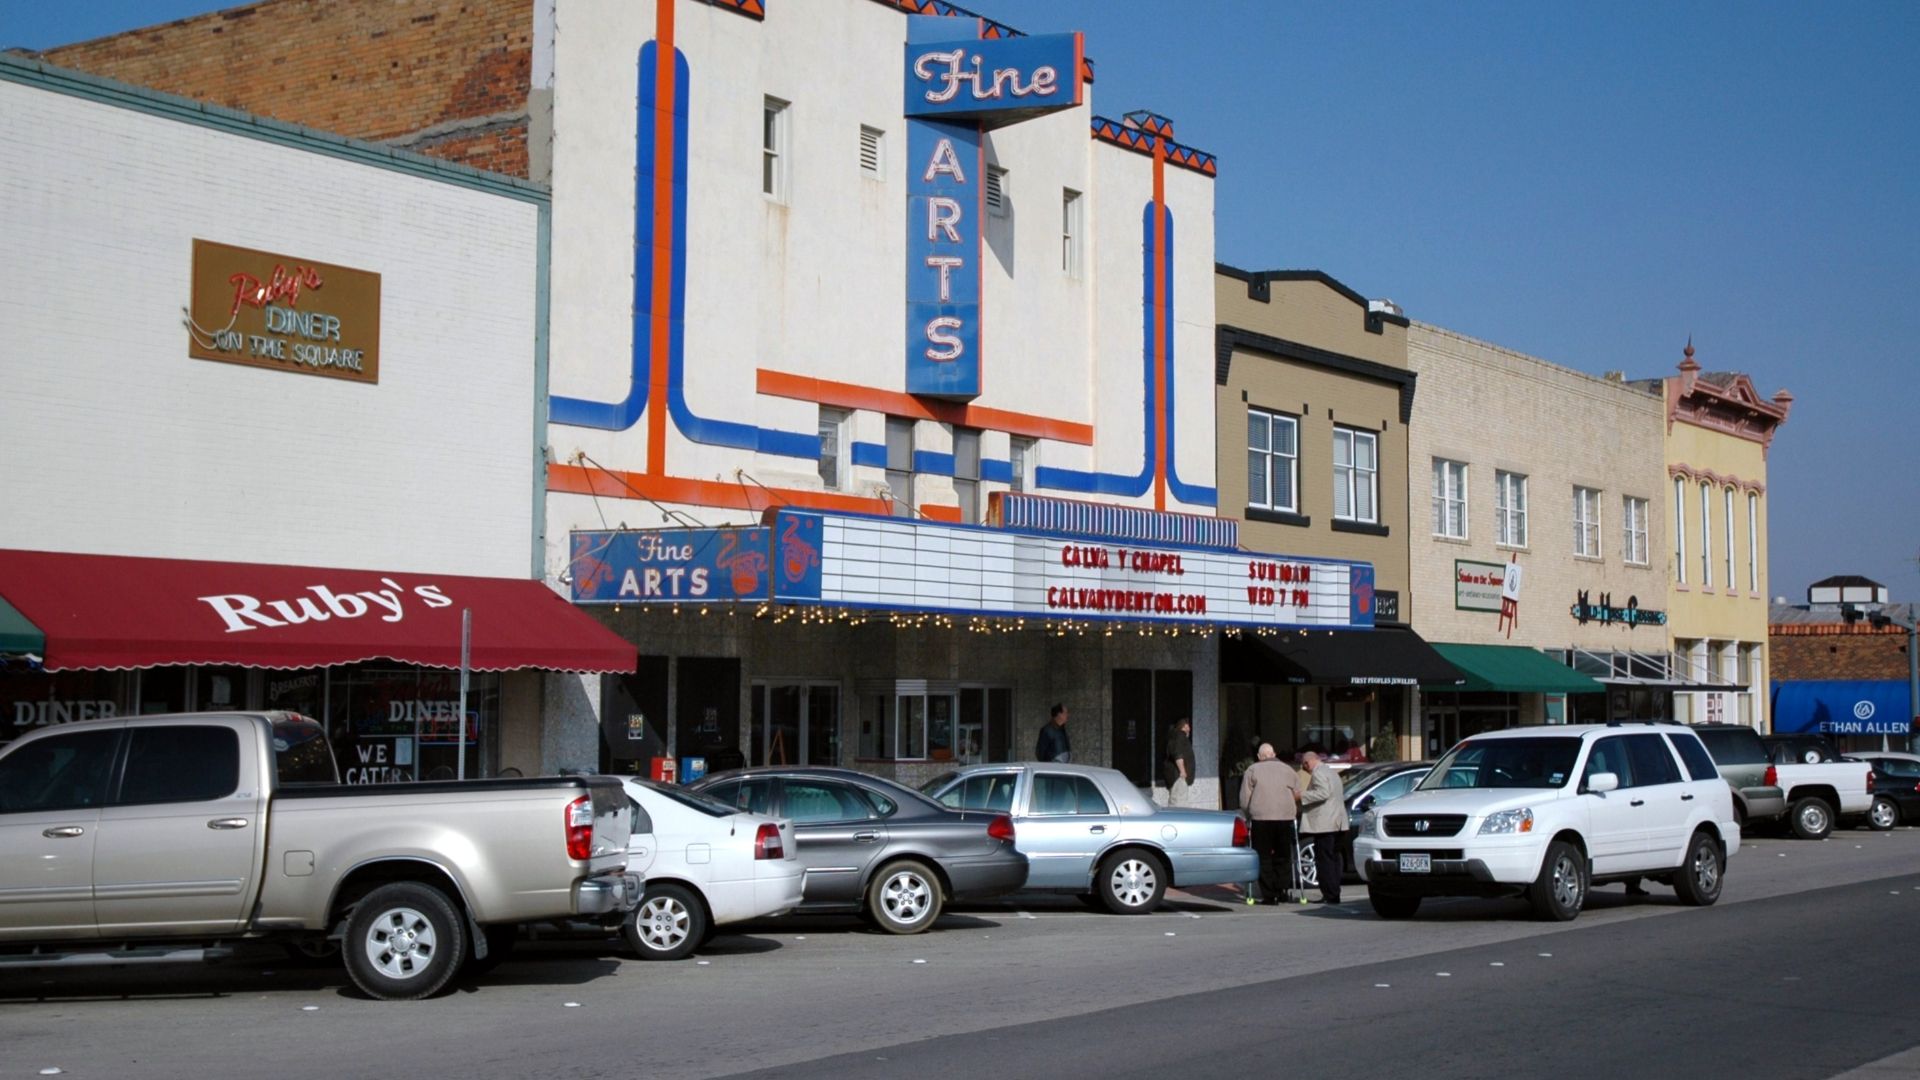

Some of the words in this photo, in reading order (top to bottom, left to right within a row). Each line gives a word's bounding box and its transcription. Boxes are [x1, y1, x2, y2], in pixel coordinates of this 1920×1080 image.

[913, 48, 1058, 103] Fine
[923, 138, 966, 362] ARTS
[229, 264, 323, 317] Ruby's
[265, 304, 341, 343] DINER
[213, 330, 243, 351] ON
[250, 335, 288, 360] THE
[293, 343, 364, 372] SQUARE
[638, 535, 693, 562] Fine
[1132, 551, 1184, 576] CHAPEL
[1248, 560, 1276, 581] SUN
[619, 567, 709, 597] ARTS
[197, 577, 453, 633] Ruby's
[1047, 586, 1207, 615] CALVARYDENTON.COM
[1247, 586, 1275, 606] WED
[1279, 588, 1286, 607] 7
[1292, 589, 1309, 608] PM
[1391, 677, 1418, 685] JEWELERS
[13, 700, 117, 726] DINER
[388, 700, 465, 722] DINER
[1820, 721, 1862, 733] ETHAN
[1866, 722, 1910, 733] ALLEN
[356, 744, 388, 764] WE
